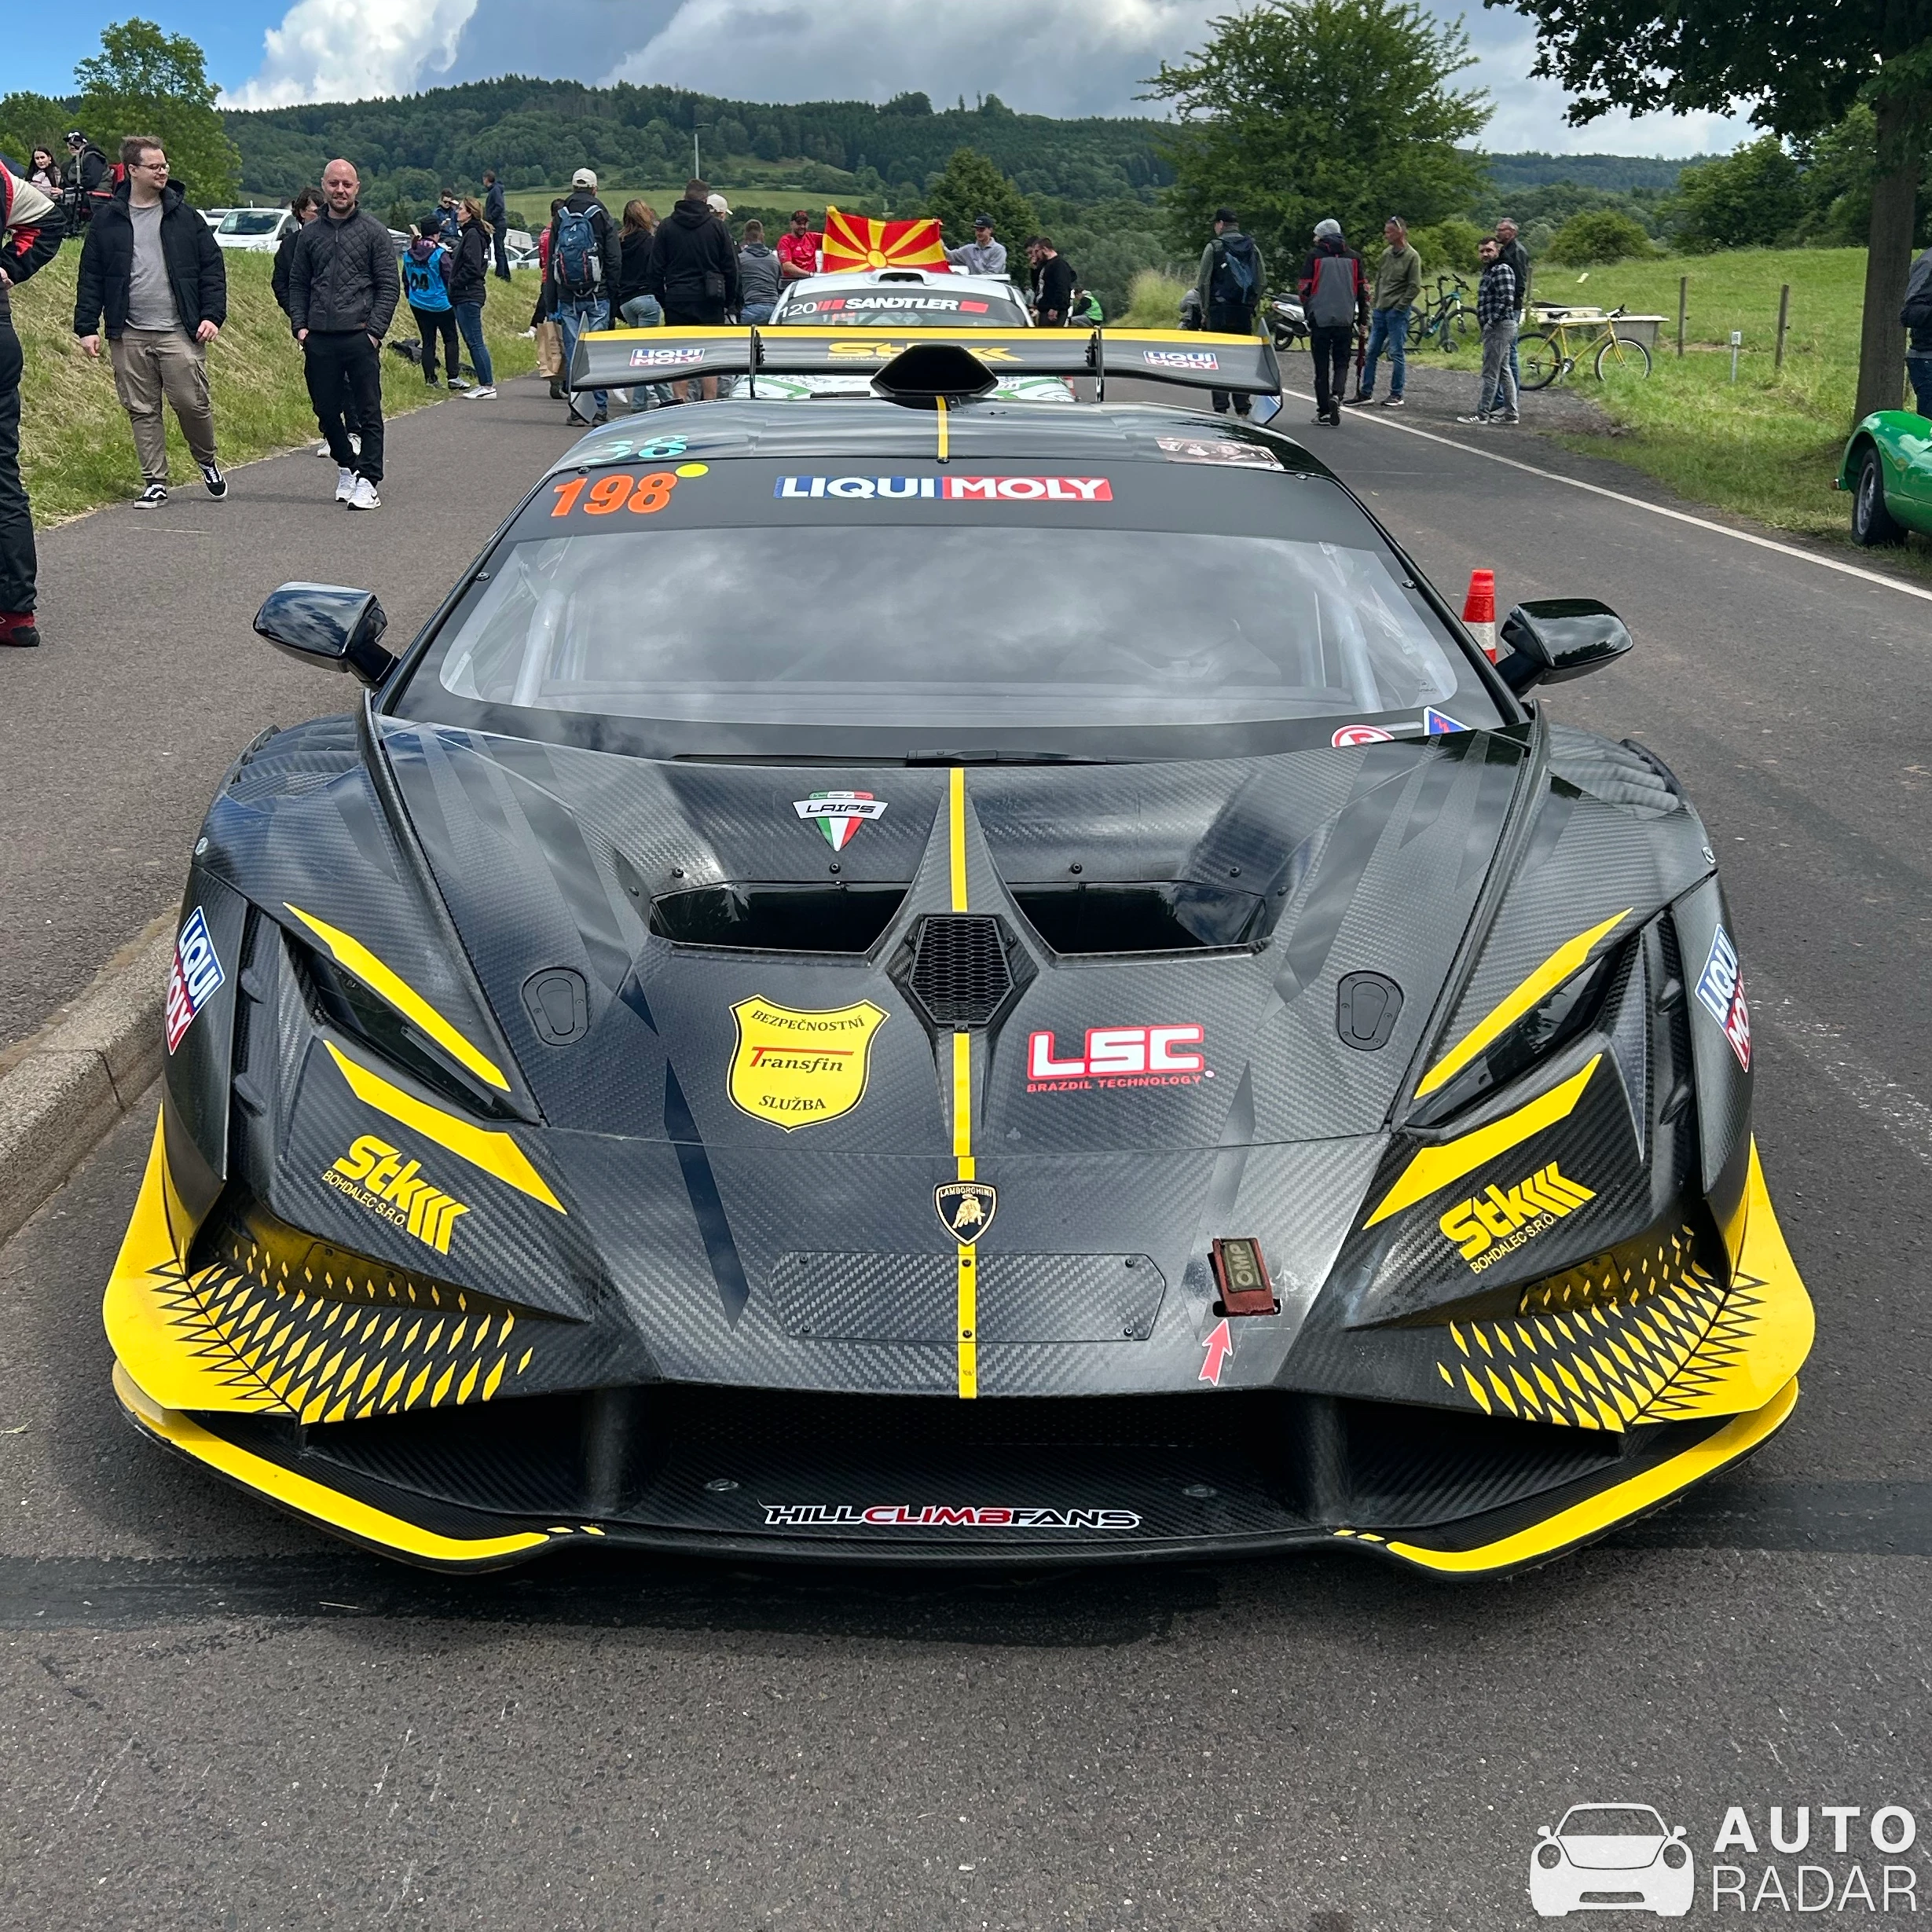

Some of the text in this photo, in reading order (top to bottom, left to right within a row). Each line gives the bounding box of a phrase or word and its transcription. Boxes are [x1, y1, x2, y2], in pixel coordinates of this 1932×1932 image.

[780, 302, 817, 318] 120
[844, 298, 959, 311] SANDTLER
[633, 356, 701, 366] MOLY
[636, 349, 701, 358] LIQUI
[1148, 351, 1215, 361] LIQUI
[1149, 359, 1217, 370] MOLY
[551, 471, 679, 519] 198
[781, 477, 1106, 499] LIQUI MOLY
[806, 804, 877, 814] LAIPS
[178, 913, 220, 1008] LIQUI
[1699, 931, 1739, 1023] LIQUI
[750, 1010, 865, 1032] BEZPEČNOSTNÍ
[750, 1047, 854, 1074] Transfin
[1028, 1025, 1204, 1080] LSC
[1027, 1076, 1201, 1093] BRAZDIL TECHNOLOGY
[758, 1095, 827, 1111] SLUŽBA
[321, 1170, 378, 1208] BOHDALEC
[940, 1186, 992, 1198] LAMBORGHINI
[1469, 1231, 1527, 1274] BOHDALEC
[1229, 1243, 1254, 1286] OMP
